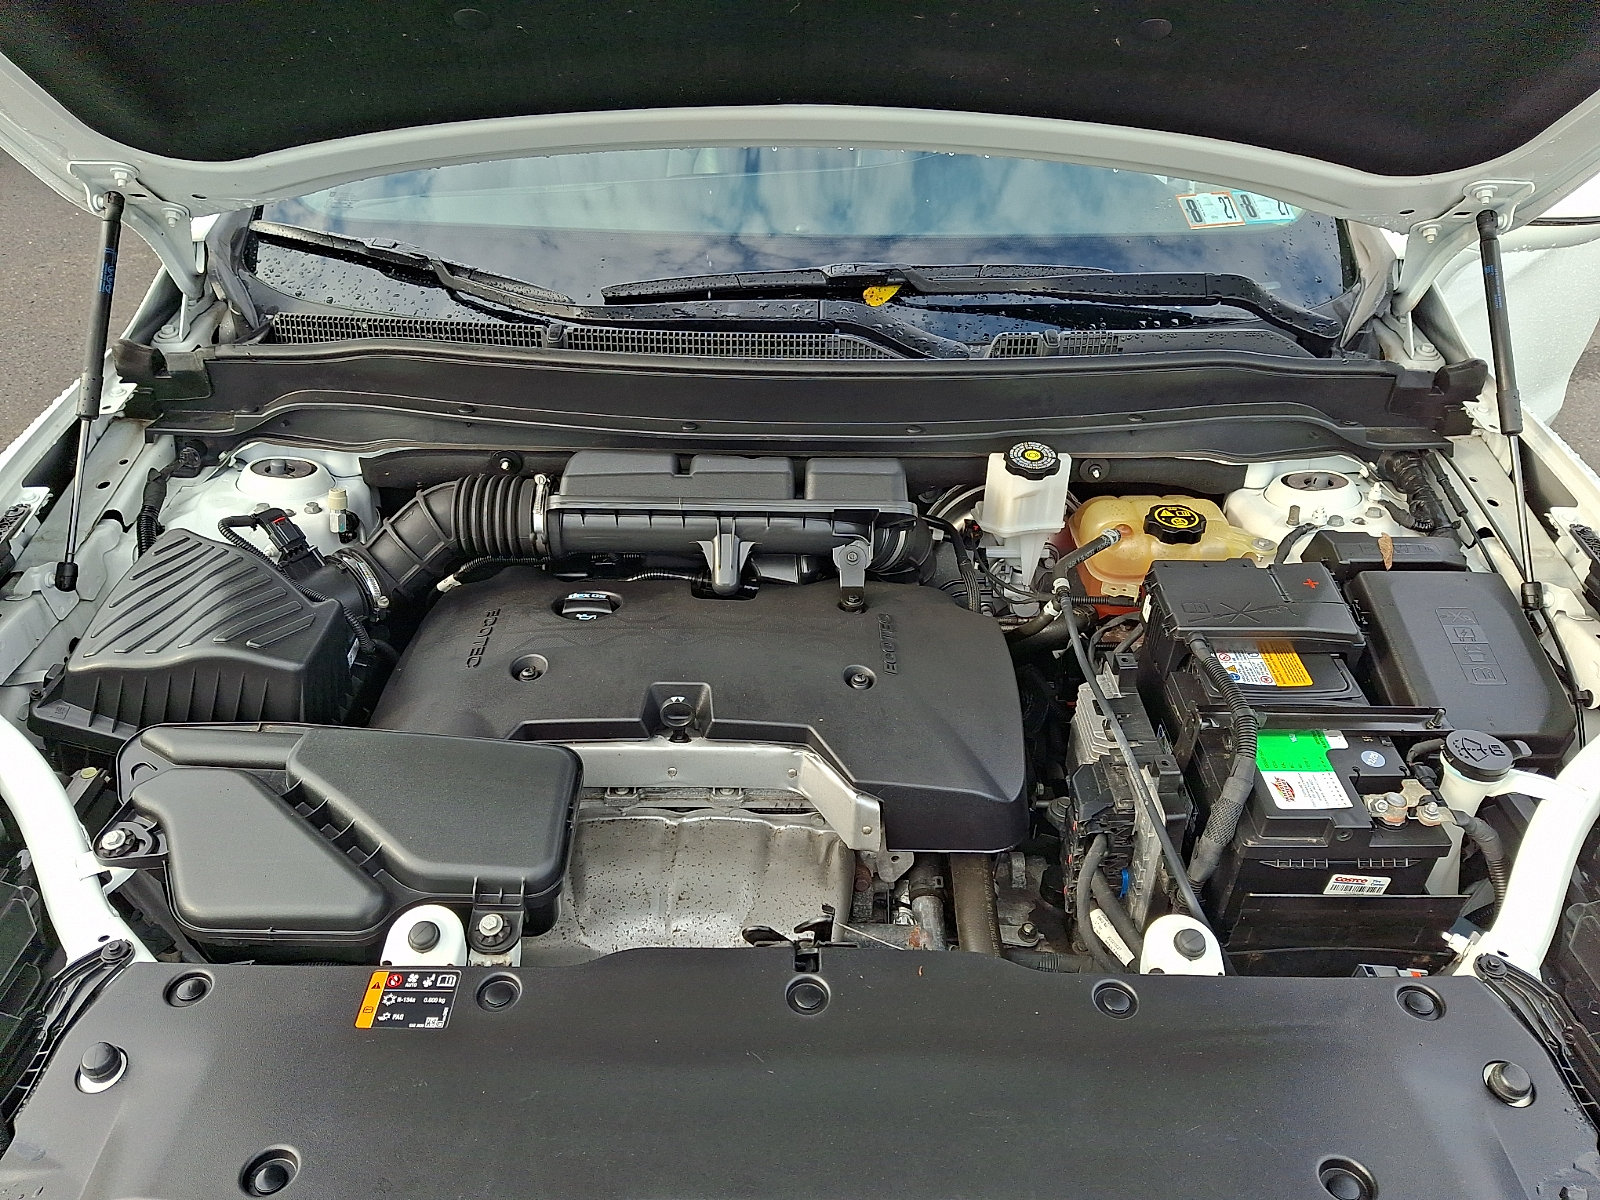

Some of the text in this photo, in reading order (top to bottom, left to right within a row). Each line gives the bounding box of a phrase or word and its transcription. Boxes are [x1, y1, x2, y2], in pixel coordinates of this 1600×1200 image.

[1186, 199, 1203, 223] 8
[1240, 194, 1258, 218] 8
[466, 608, 501, 669] ECOTEC
[878, 613, 898, 675] ECOTEC
[392, 1013, 405, 1021] PAG
